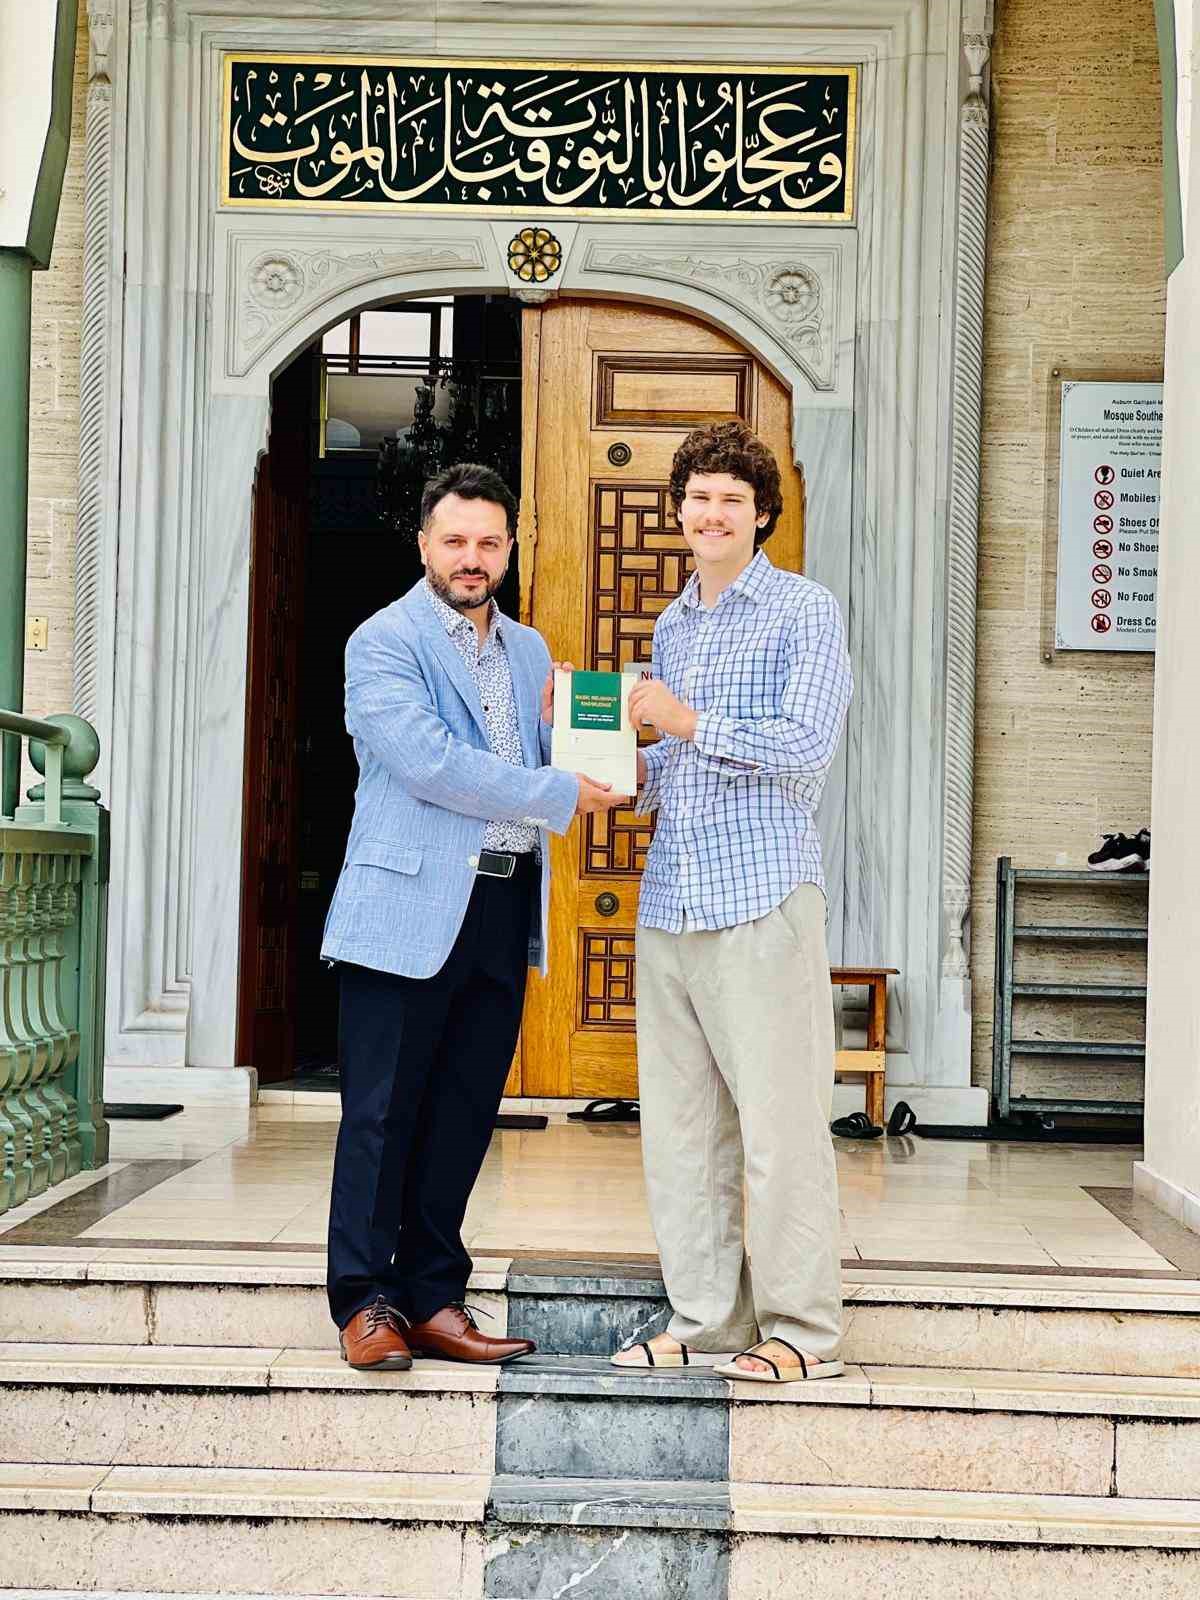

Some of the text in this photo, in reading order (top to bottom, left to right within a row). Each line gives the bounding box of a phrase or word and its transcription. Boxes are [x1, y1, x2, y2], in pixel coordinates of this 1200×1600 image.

[1104, 409, 1134, 423] Mosque
[1121, 468, 1145, 478] Quiet
[1120, 493, 1156, 503] Mobiles
[1119, 517, 1147, 527] Shoes
[1119, 542, 1131, 552] No
[1118, 567, 1158, 577] No Smok
[1117, 592, 1154, 602] No Food
[1116, 617, 1157, 626] Dress Co
[641, 671, 653, 681] N
